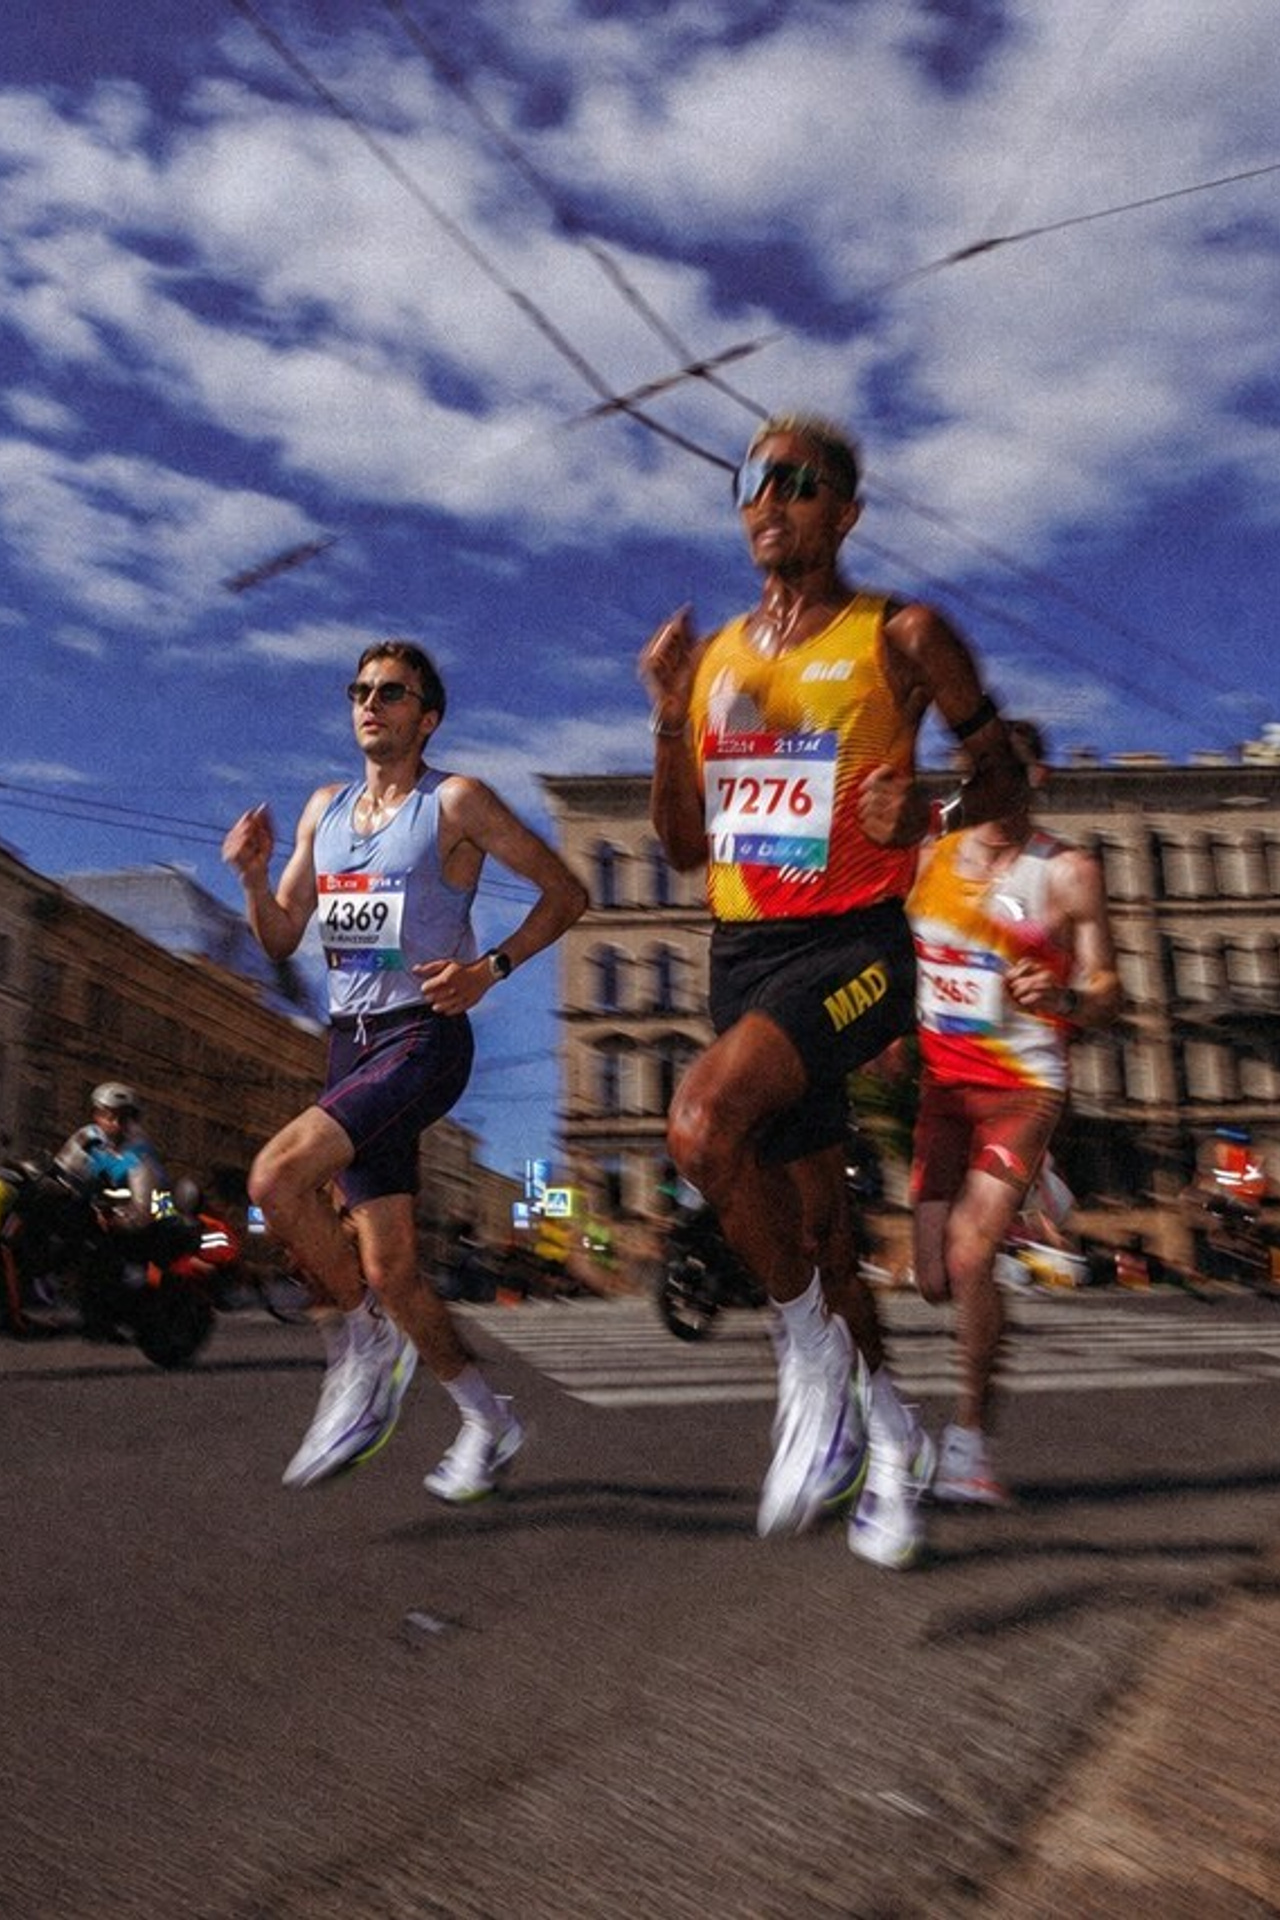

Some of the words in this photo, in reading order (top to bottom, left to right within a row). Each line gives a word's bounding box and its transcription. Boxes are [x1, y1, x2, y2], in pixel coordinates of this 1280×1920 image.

[717, 776, 813, 817] 7276
[326, 899, 389, 932] 4369
[822, 963, 887, 1033] MAD
